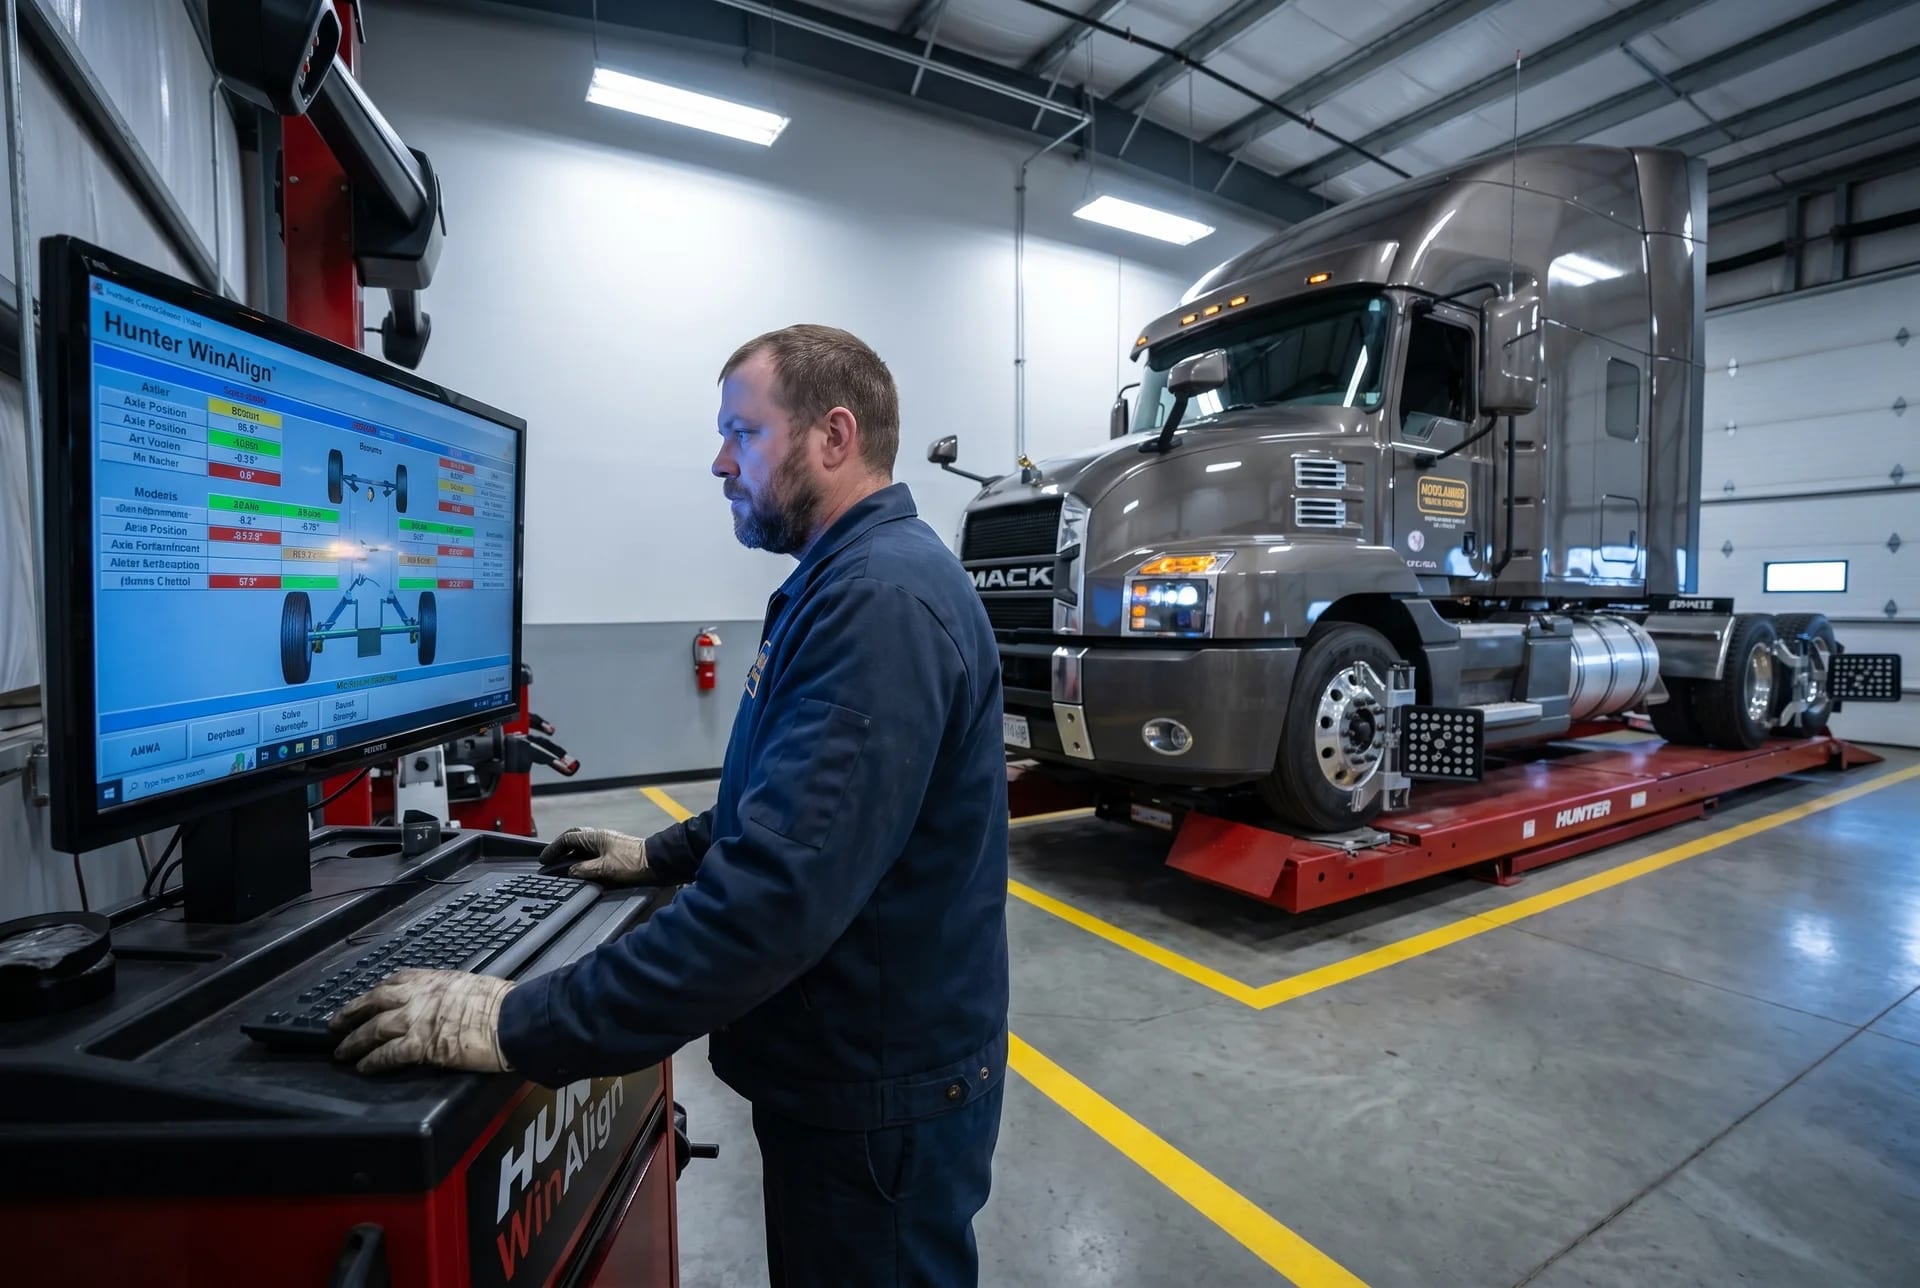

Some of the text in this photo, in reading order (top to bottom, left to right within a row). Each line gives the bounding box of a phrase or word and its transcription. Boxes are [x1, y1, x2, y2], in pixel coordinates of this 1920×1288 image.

[105, 310, 272, 383] Hunter WinAlign
[149, 402, 187, 419] Position
[149, 419, 187, 436] Position
[150, 524, 188, 536] Position
[966, 566, 1055, 588] MACK
[1555, 799, 1612, 829] HUNTER
[497, 1078, 592, 1225] HUN
